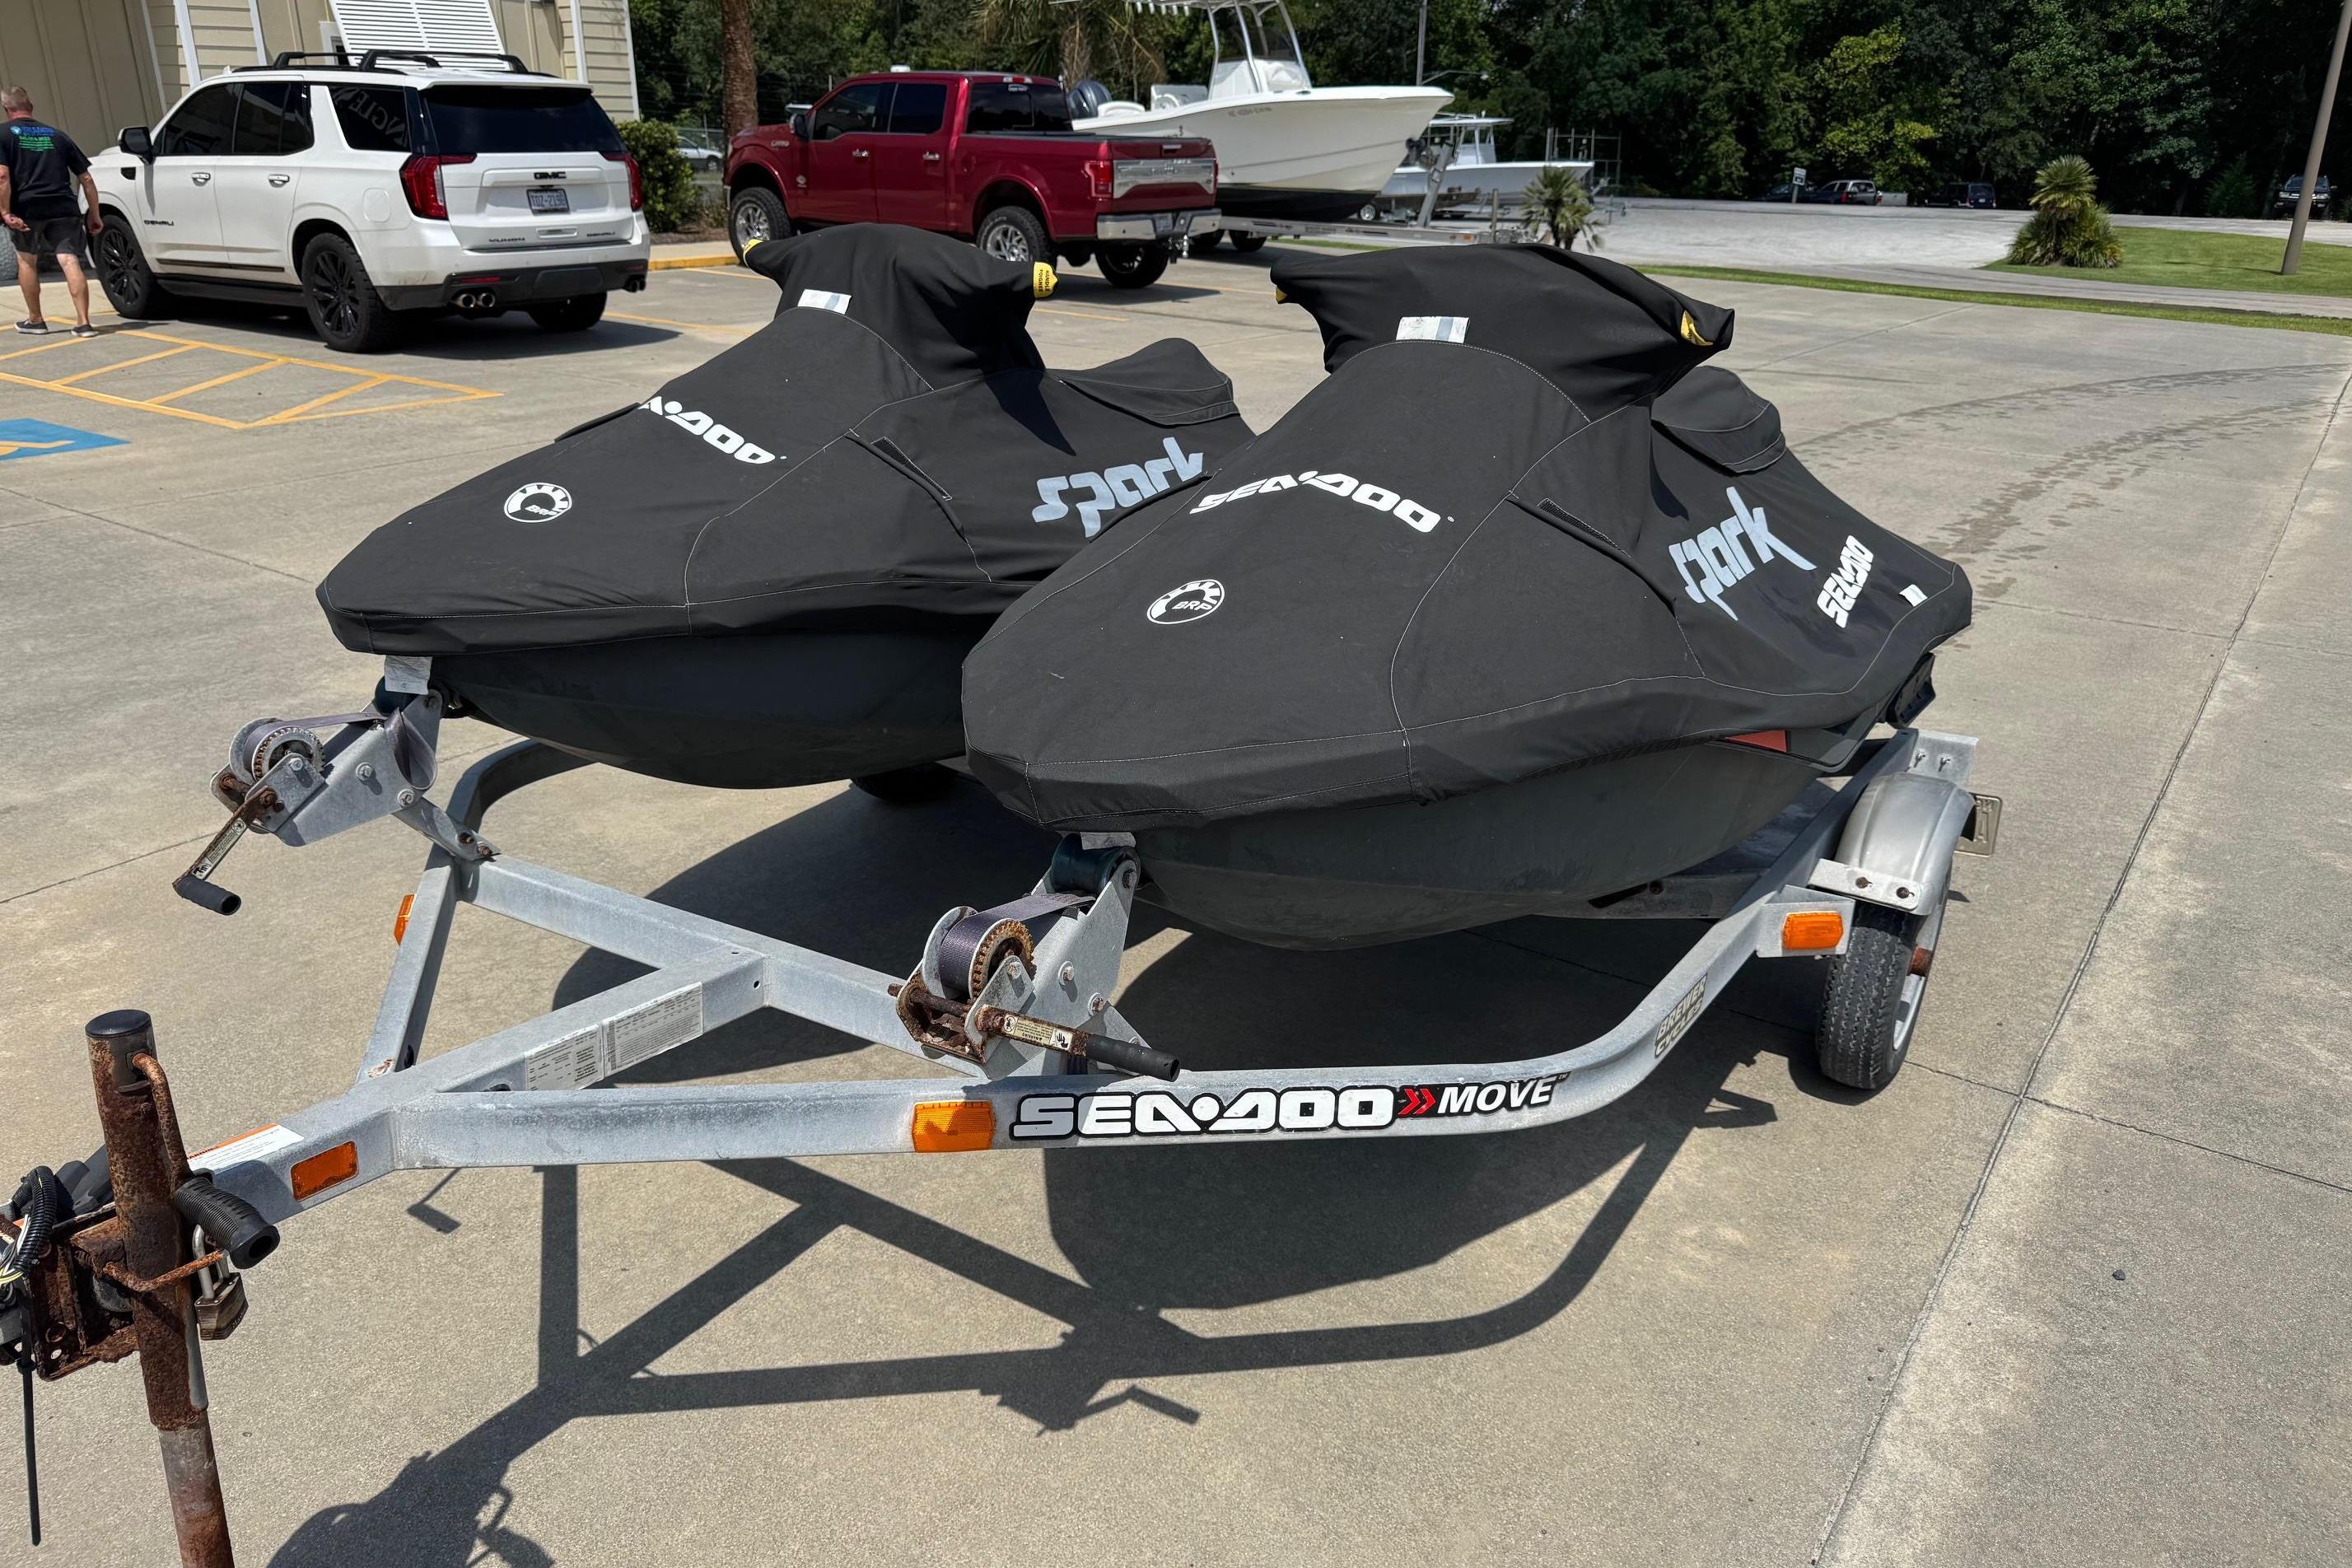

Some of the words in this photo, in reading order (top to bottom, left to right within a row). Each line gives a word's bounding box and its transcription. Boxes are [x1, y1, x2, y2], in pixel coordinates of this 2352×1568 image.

[534, 171, 567, 180] GMC
[525, 505, 558, 516] BRP
[1171, 600, 1213, 611] BRP
[1657, 975, 1707, 1040] BREWER
[1655, 996, 1702, 1057] CYCLES
